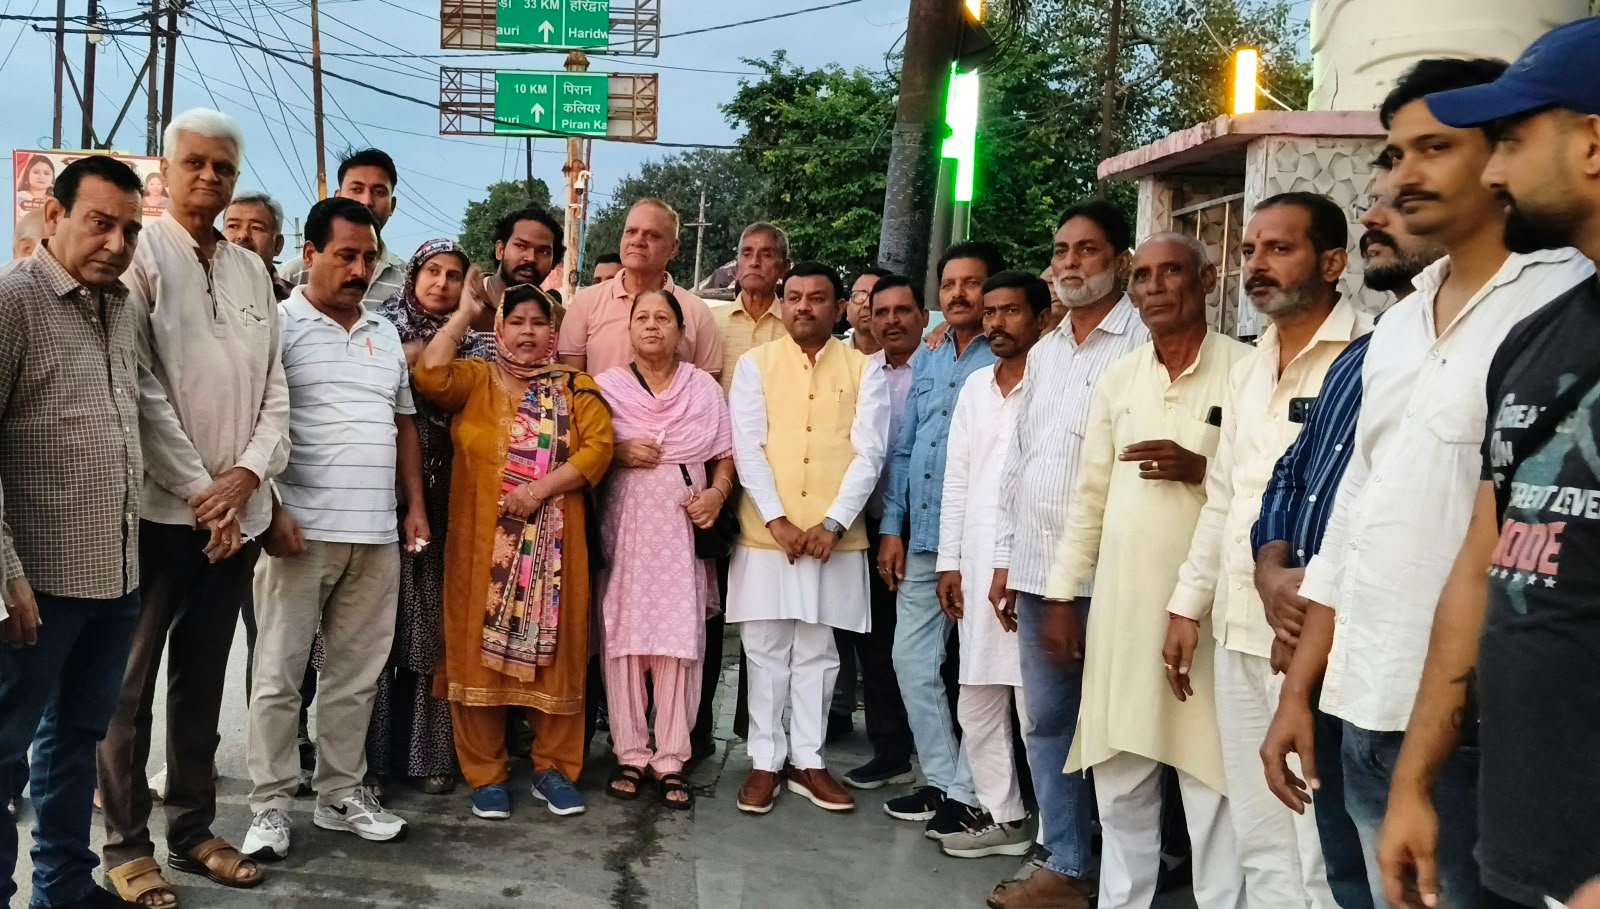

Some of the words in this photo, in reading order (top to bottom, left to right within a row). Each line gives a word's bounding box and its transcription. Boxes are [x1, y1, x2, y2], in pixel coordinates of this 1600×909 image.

[524, 0, 537, 9] 33
[540, 0, 560, 10] KM
[514, 84, 527, 94] 10
[530, 84, 548, 94] KM
[563, 81, 592, 96] पिरान
[562, 100, 601, 114] कलियर
[561, 119, 591, 130] Piran
